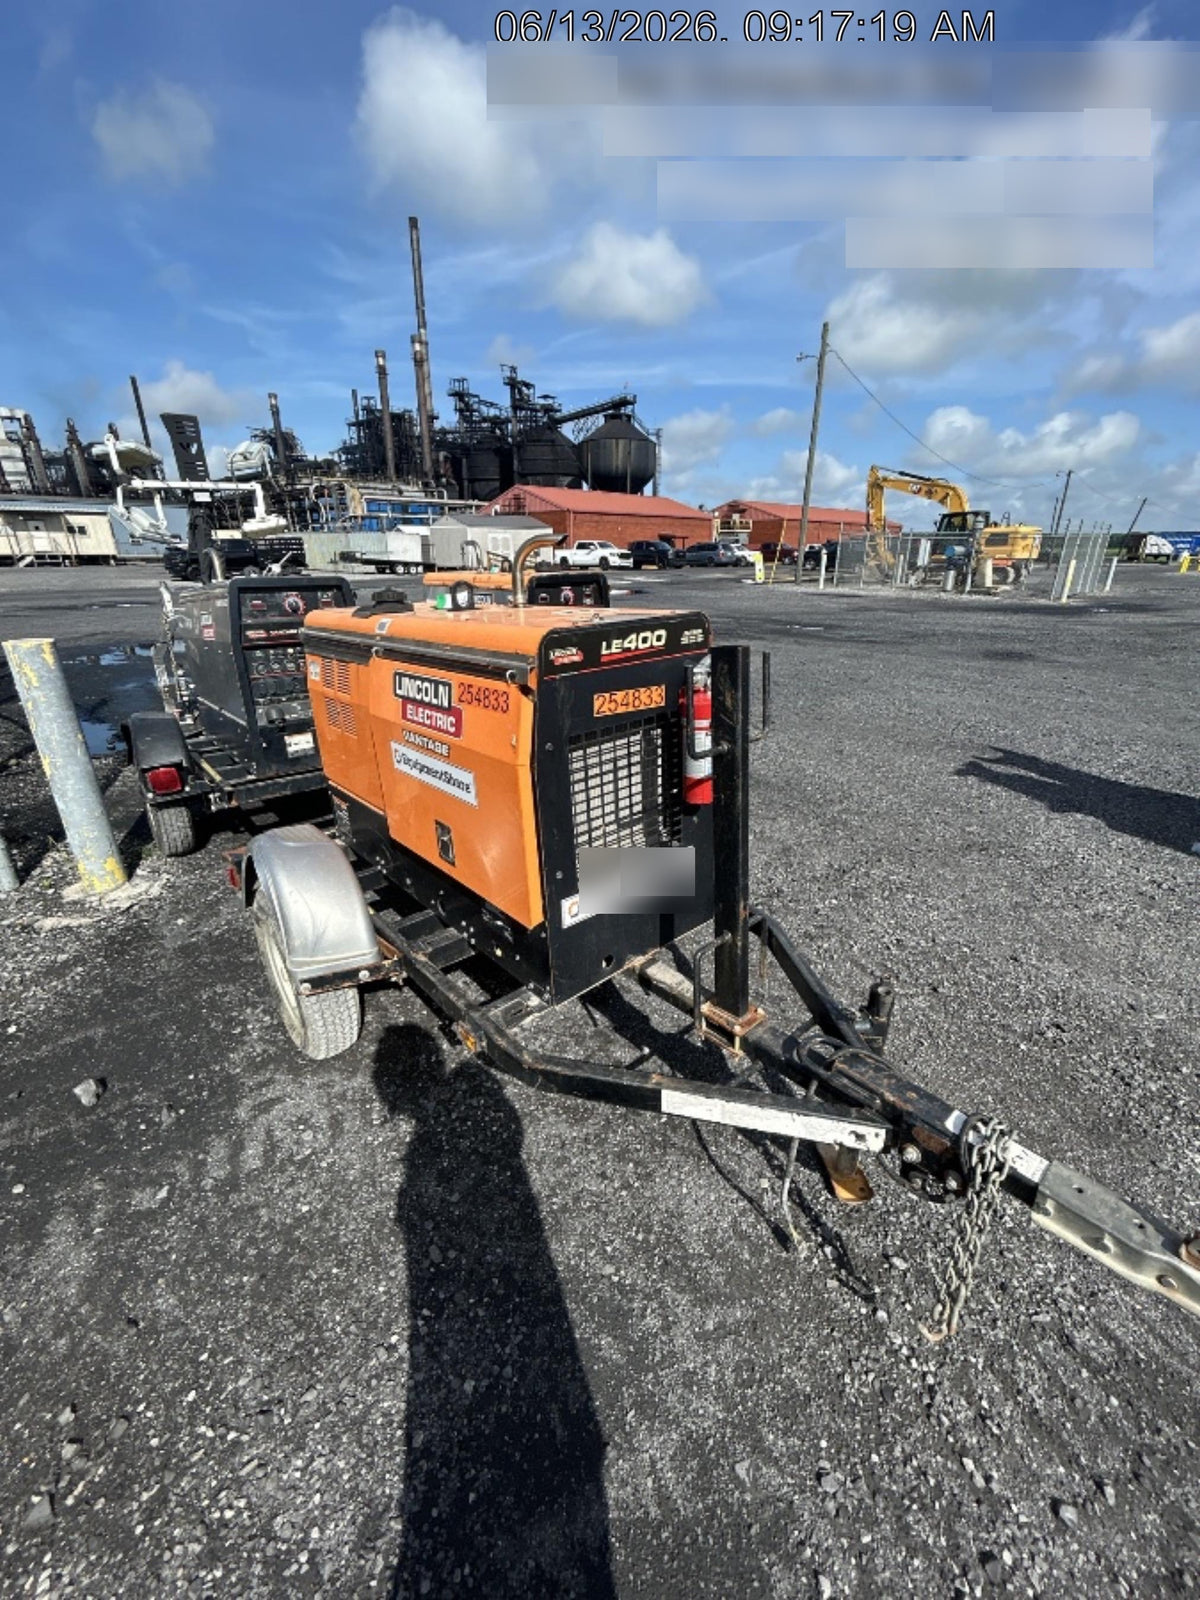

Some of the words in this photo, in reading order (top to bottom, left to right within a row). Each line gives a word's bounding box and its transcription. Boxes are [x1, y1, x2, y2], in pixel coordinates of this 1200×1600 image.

[601, 629, 667, 655] LE400
[395, 673, 450, 709] LINCOLN
[458, 682, 510, 713] 254833
[595, 687, 665, 715] 254833
[406, 703, 456, 733] ELECTRIC
